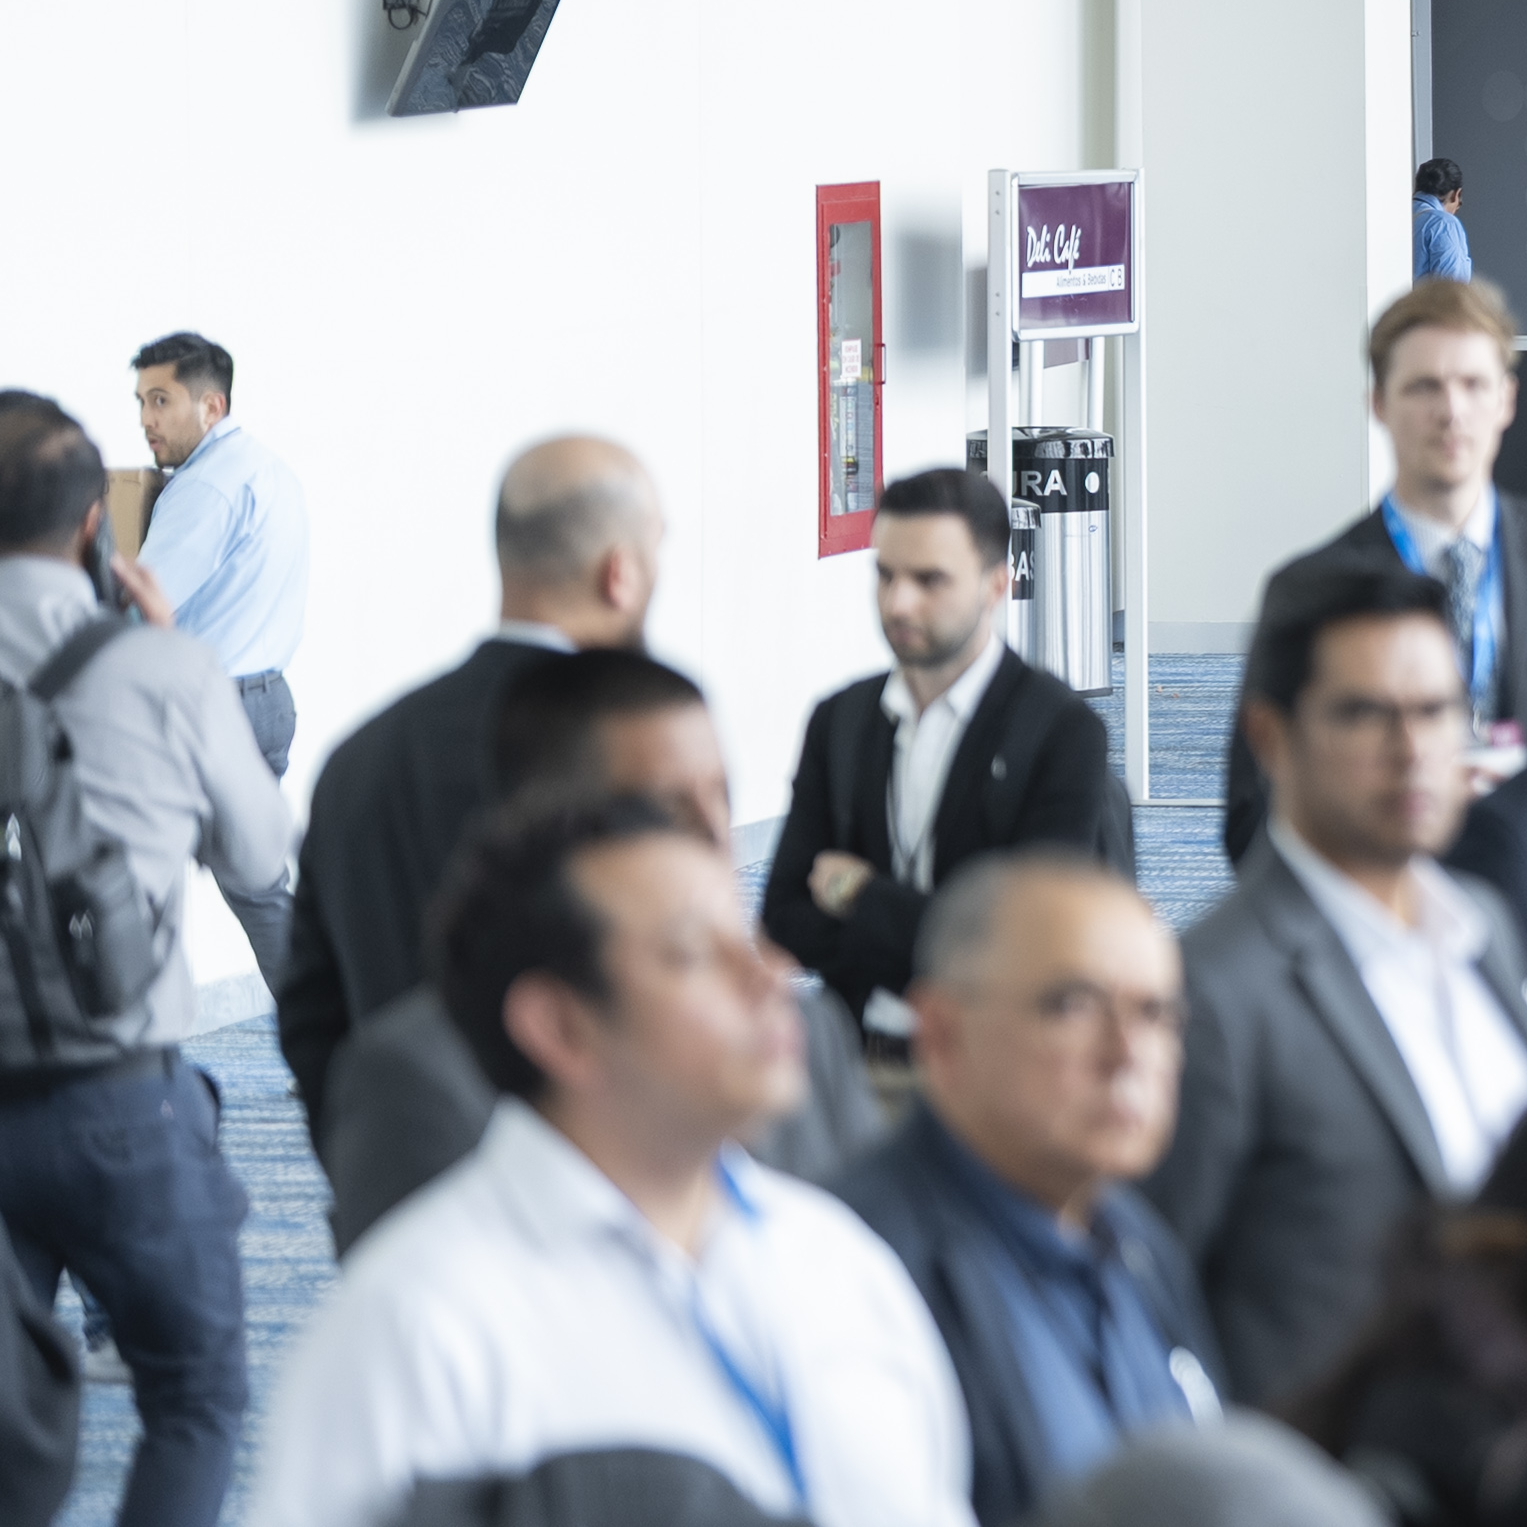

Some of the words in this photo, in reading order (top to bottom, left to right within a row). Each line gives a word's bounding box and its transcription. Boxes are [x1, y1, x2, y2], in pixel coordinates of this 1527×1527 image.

[1027, 224, 1051, 268] Deli
[1053, 223, 1081, 275] Café
[1056, 276, 1081, 288] Alimentos
[1088, 273, 1106, 286] Bebidas
